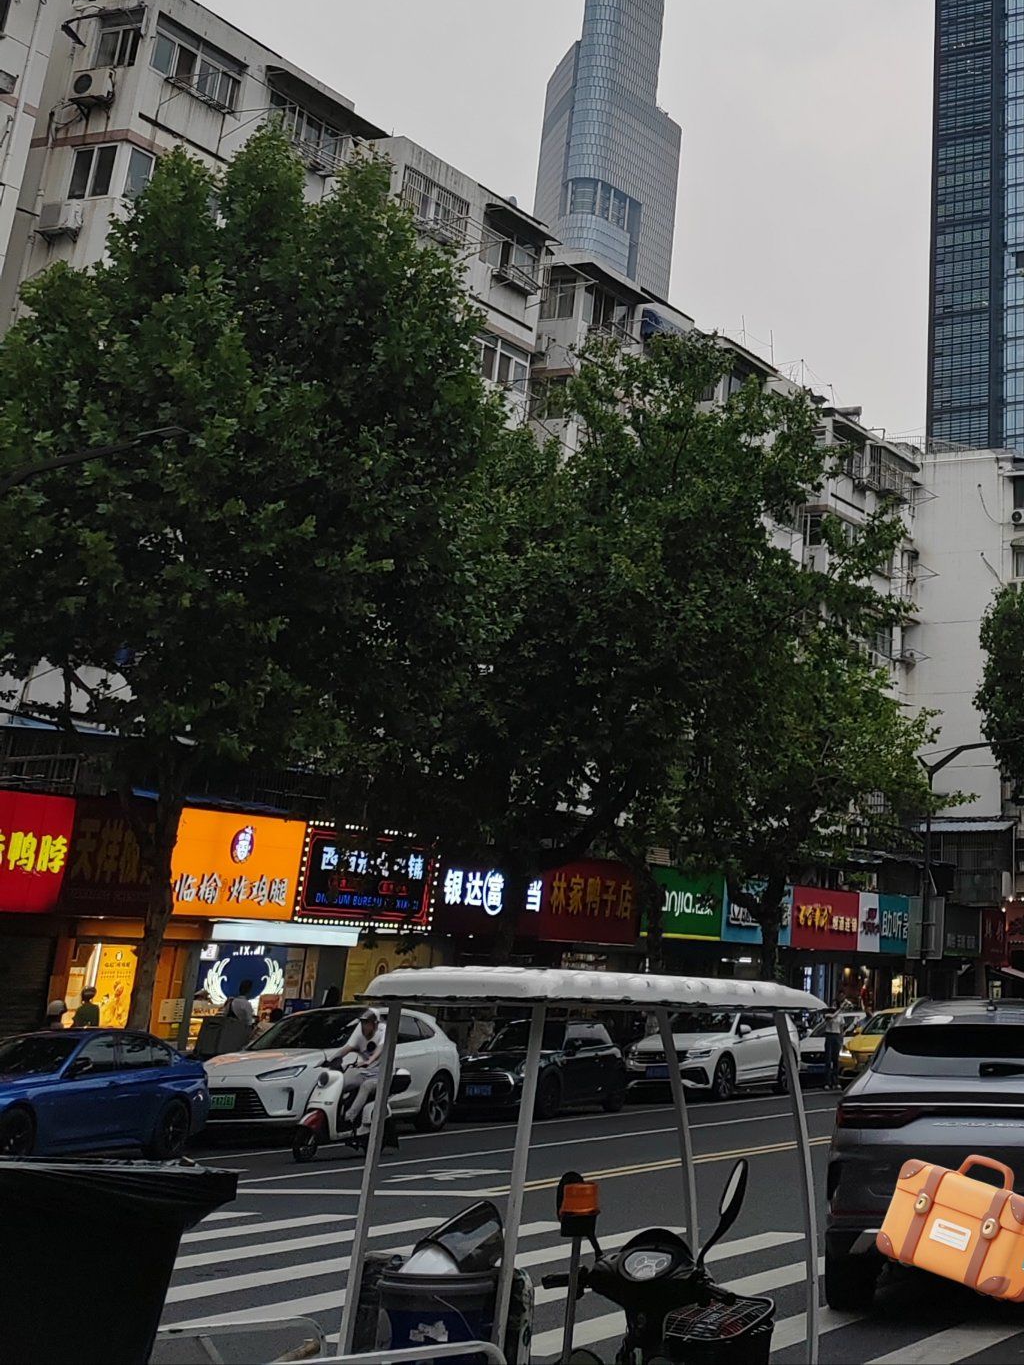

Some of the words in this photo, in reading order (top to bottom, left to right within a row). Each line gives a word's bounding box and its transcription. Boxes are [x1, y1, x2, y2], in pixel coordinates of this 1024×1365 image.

[0, 830, 68, 874] 鸭脖
[549, 871, 634, 920] 林家鸭子店
